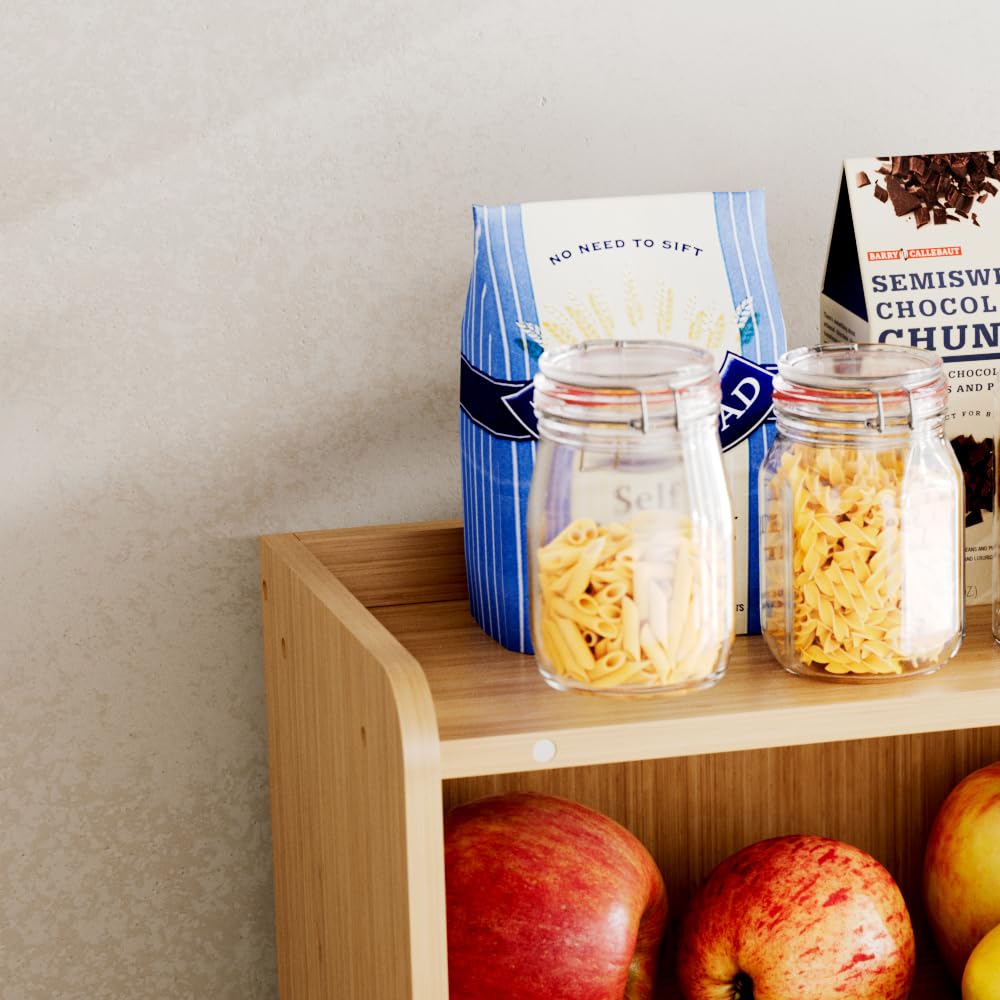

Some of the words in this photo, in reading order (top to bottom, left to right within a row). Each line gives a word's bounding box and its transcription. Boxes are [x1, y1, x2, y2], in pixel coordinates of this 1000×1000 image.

[548, 250, 573, 266] NO
[577, 239, 626, 255] NEED
[632, 238, 655, 249] TO
[661, 240, 705, 257] SIFT
[869, 250, 899, 261] BARRY
[909, 247, 961, 258] CALLEBAUT
[956, 383, 983, 393] AND
